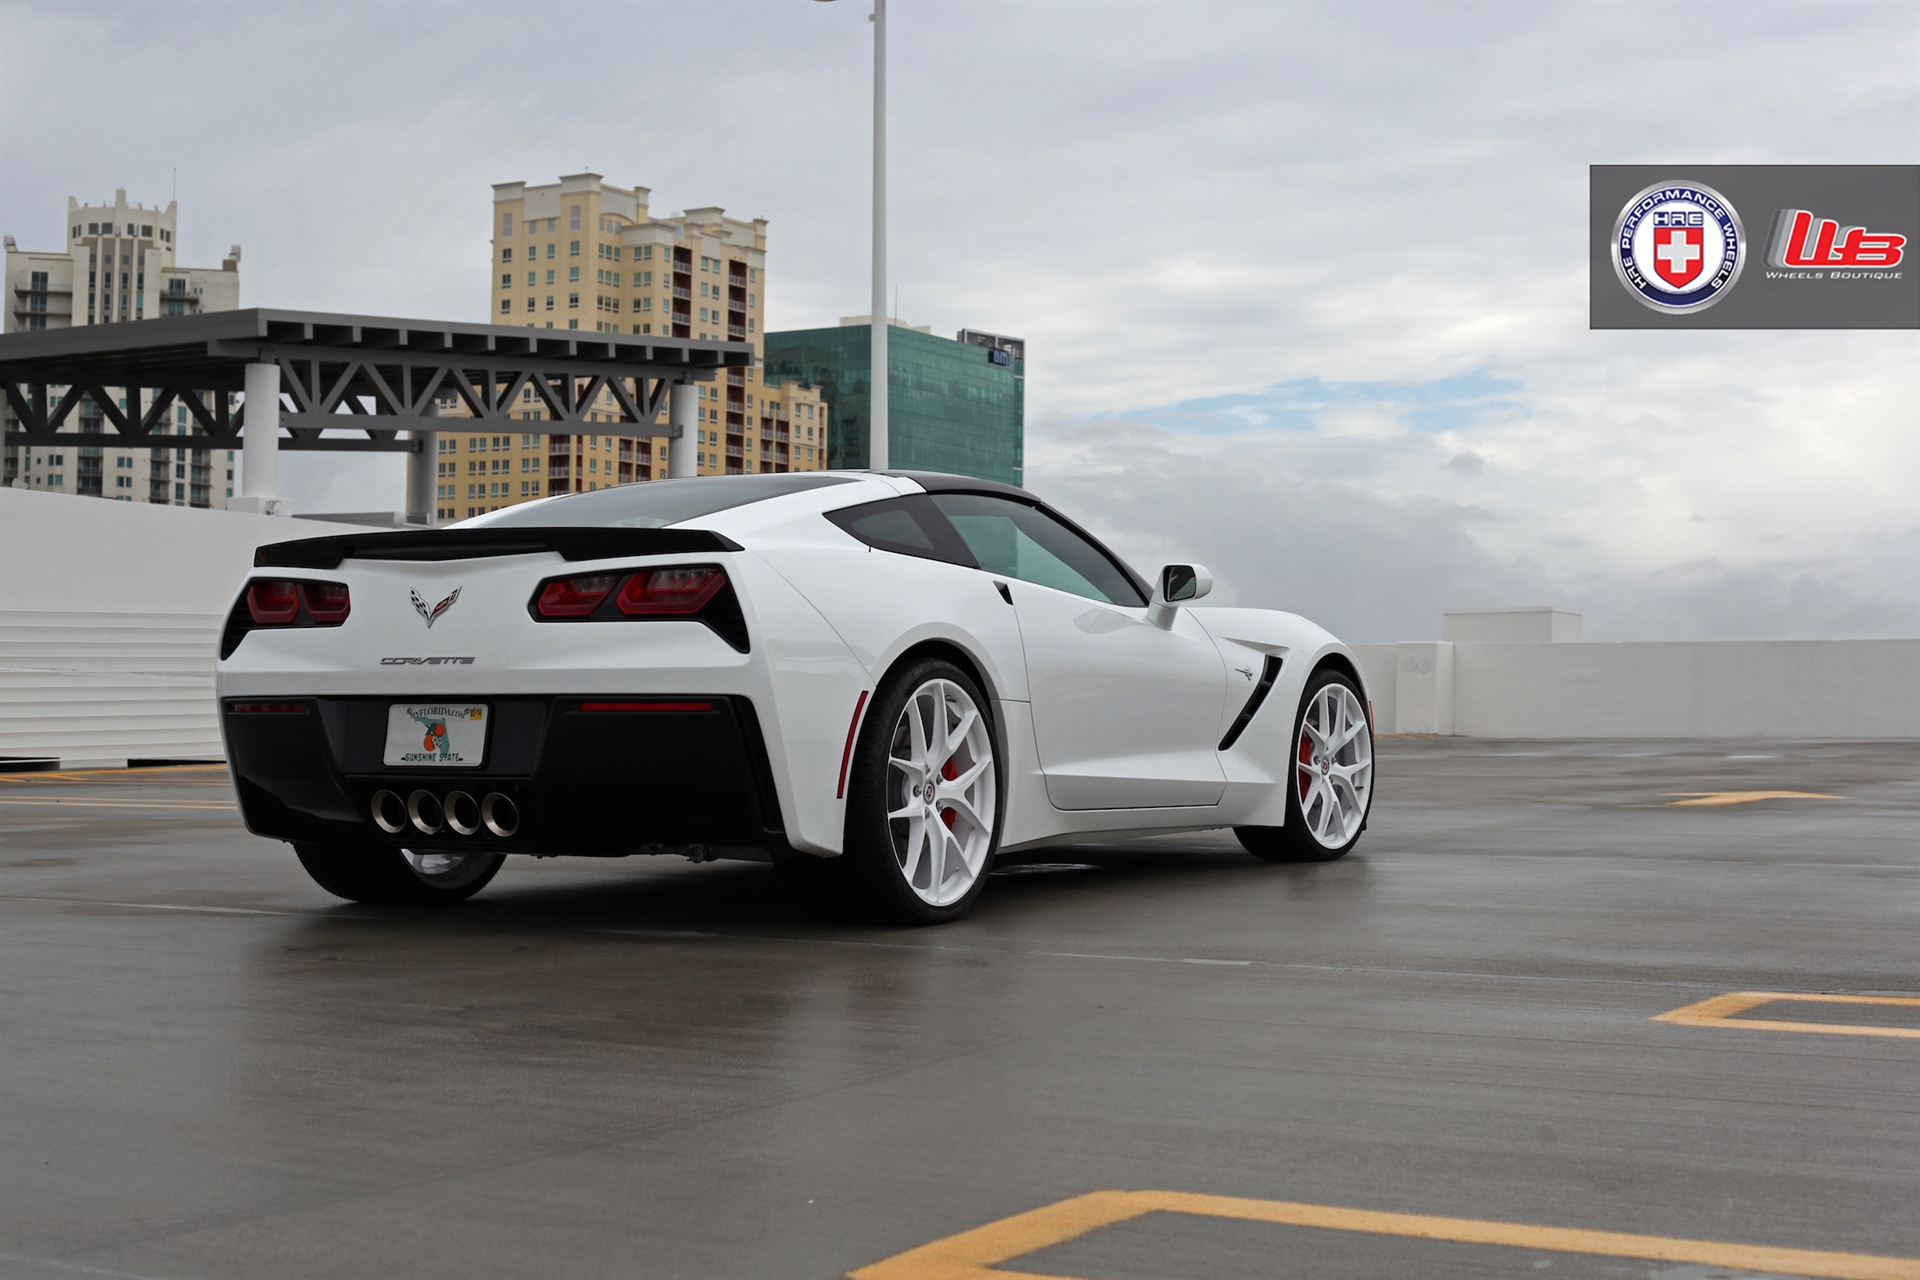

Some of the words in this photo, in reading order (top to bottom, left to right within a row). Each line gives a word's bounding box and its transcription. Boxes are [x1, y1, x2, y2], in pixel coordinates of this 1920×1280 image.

[380, 656, 475, 665] CORVETTE
[405, 753, 436, 762] SUNSHINE
[439, 753, 460, 762] STATE
